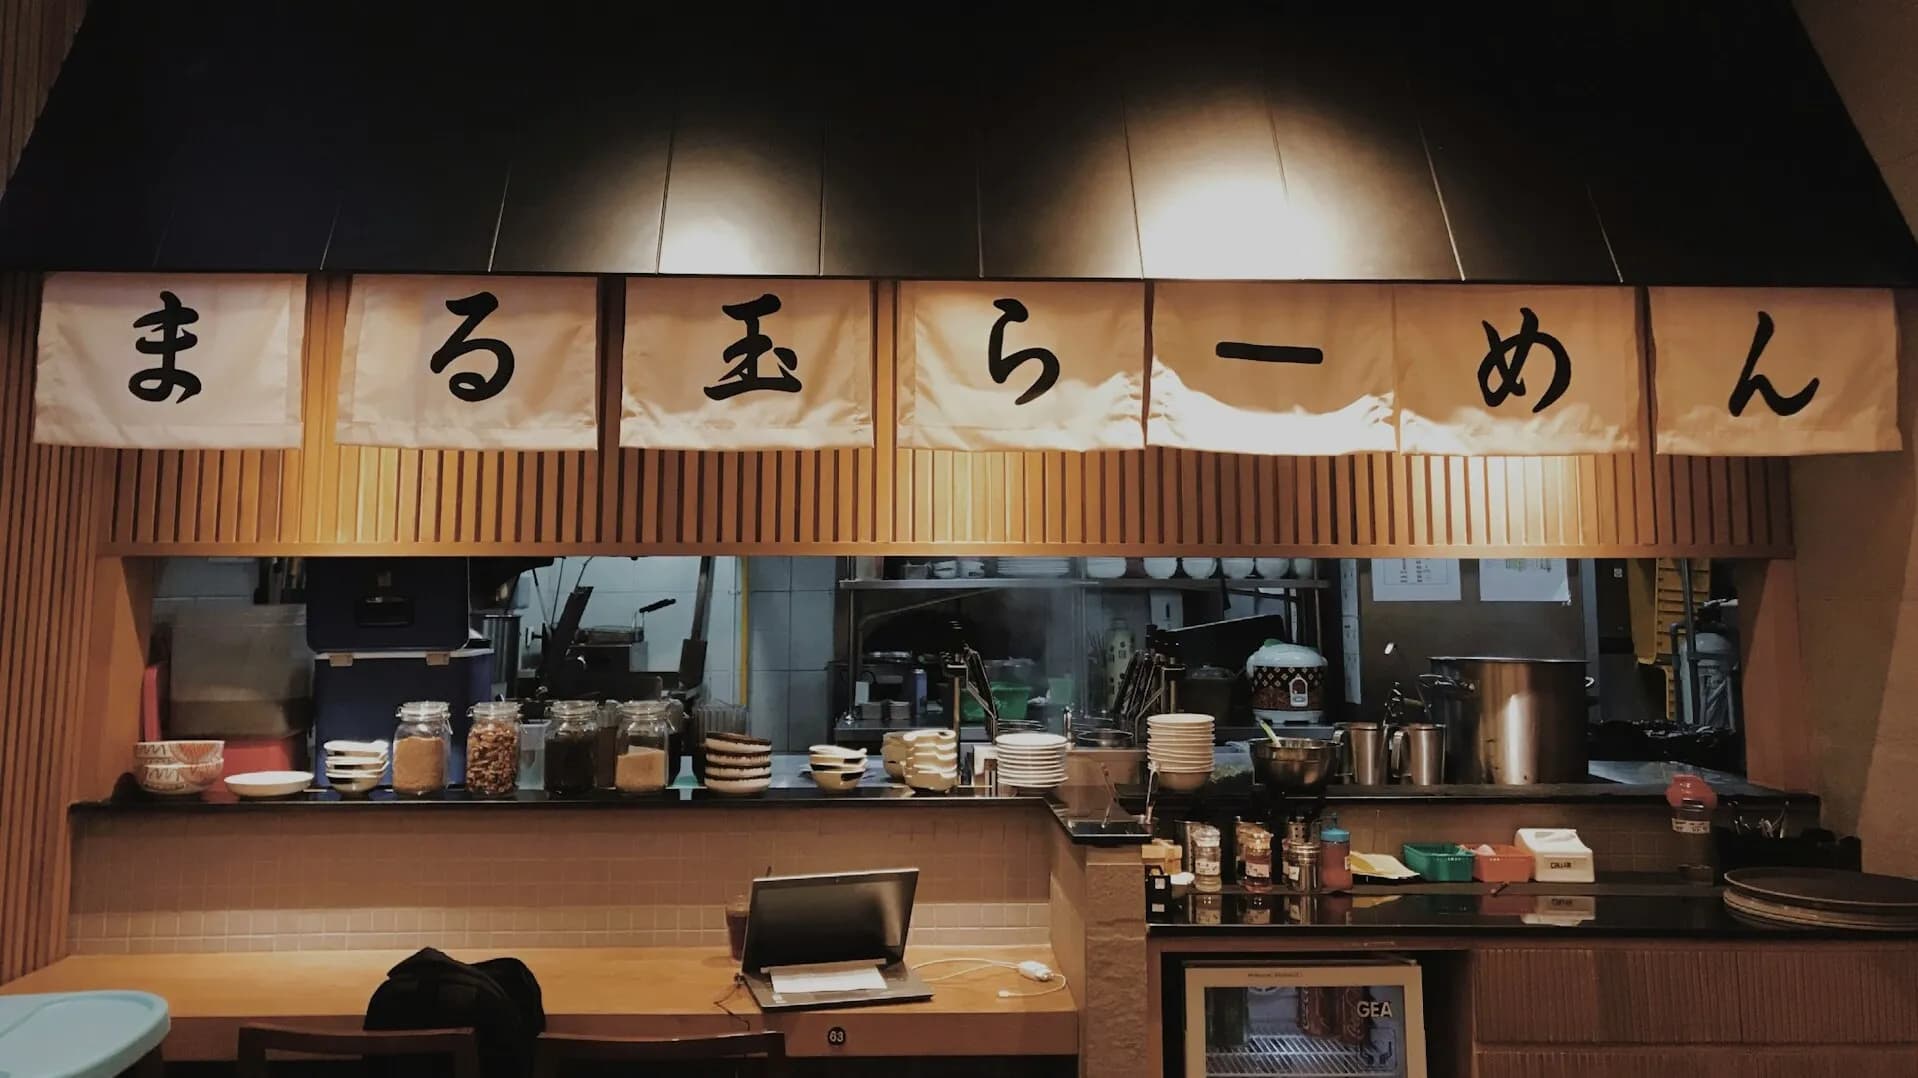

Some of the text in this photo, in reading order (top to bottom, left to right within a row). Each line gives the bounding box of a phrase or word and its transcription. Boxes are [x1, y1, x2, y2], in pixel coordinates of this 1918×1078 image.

[129, 291, 201, 404] ま
[431, 292, 515, 402] る
[704, 294, 802, 401] 玉
[989, 298, 1060, 405] ら
[1478, 307, 1571, 413] め
[1729, 311, 1820, 417] ん
[1357, 1001, 1393, 1018] GEA
[829, 1030, 844, 1042] 63
